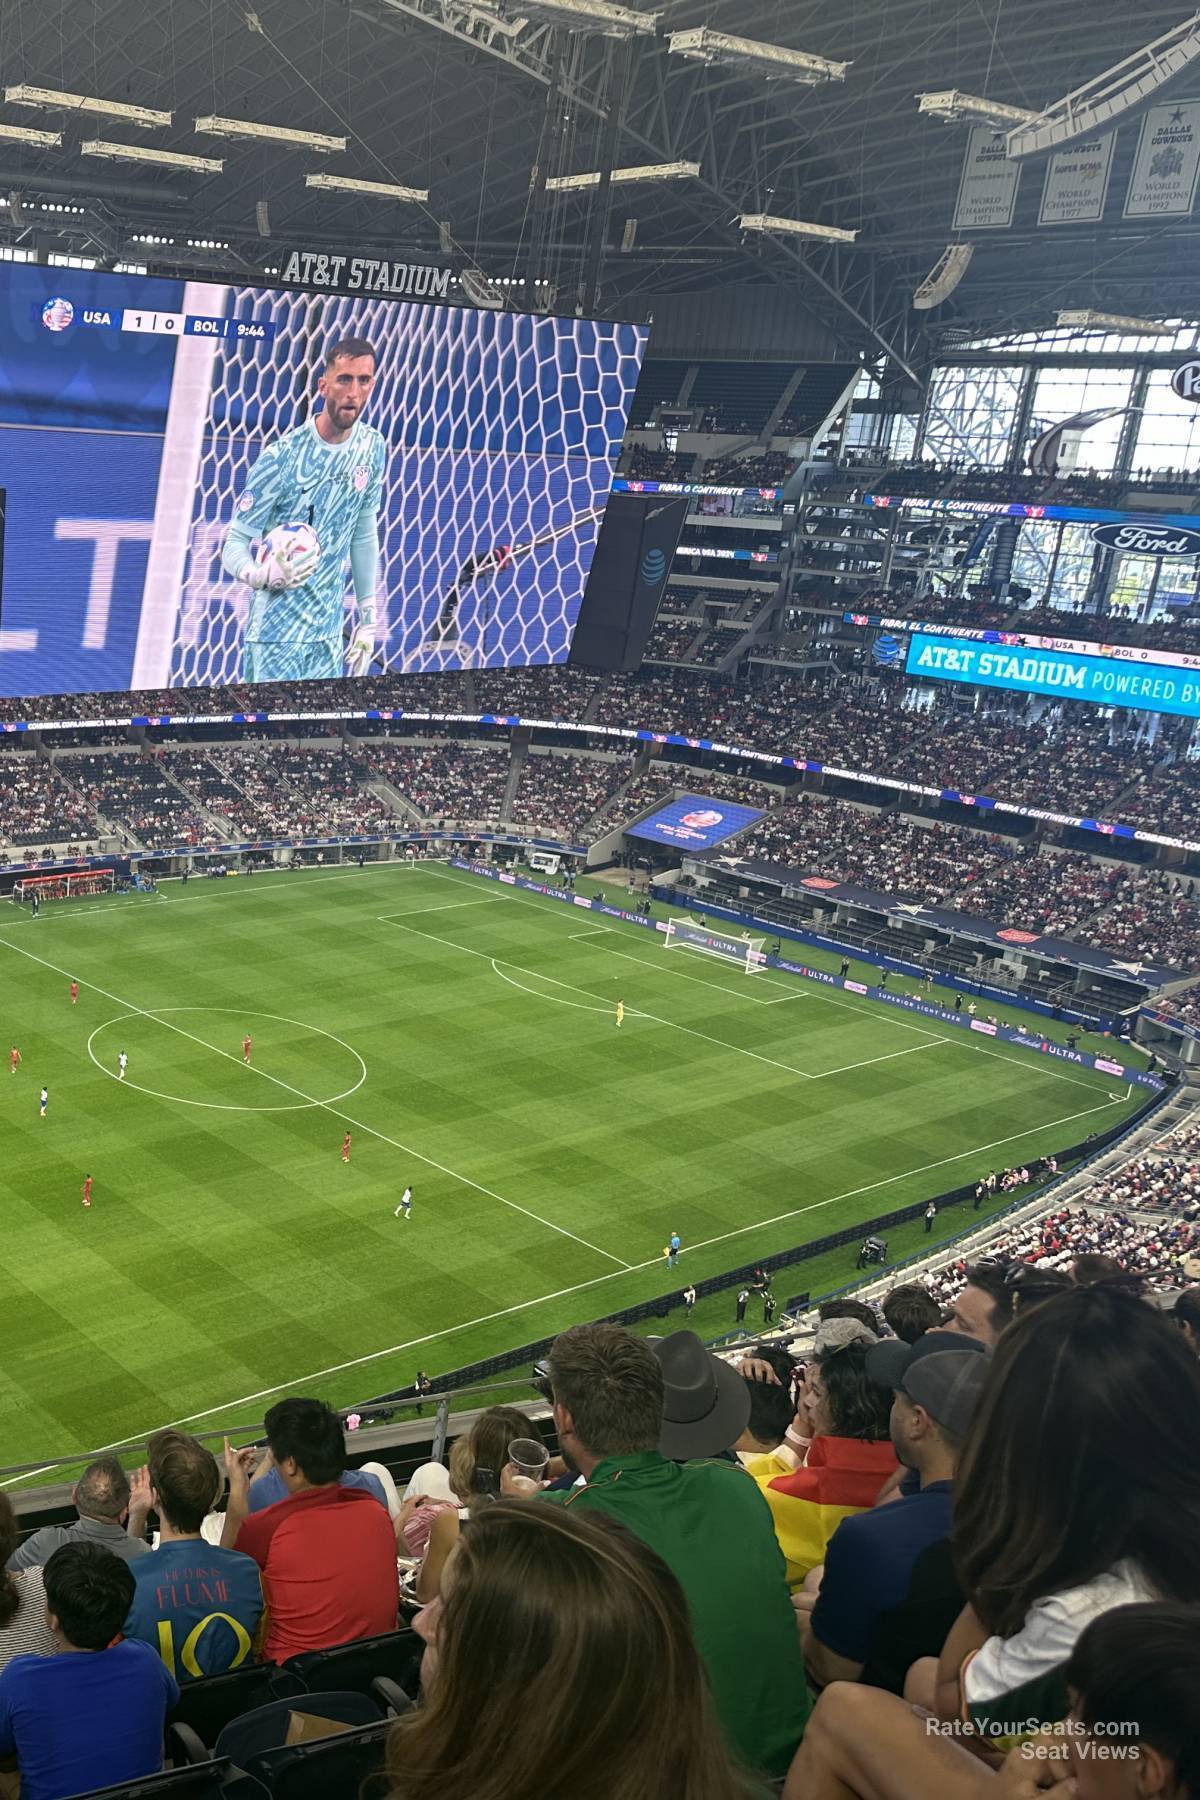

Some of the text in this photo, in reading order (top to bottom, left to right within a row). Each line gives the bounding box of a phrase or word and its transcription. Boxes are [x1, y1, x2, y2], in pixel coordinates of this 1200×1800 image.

[1157, 125, 1192, 136] DALLAS
[1151, 134, 1194, 145] COWBOYS
[1145, 182, 1180, 191] WORLD
[1058, 190, 1091, 199] WORLD
[1132, 192, 1189, 202] CHAMPIONS
[281, 252, 451, 297] AT&T STADIUM
[83, 311, 266, 338] USA 1 0 BOL 9:44
[658, 483, 745, 496] VIBRA O CONTINENTE
[902, 498, 1010, 513] VIBRA EL CONTINENTE
[1114, 527, 1189, 552] Ford
[702, 547, 716, 557] USA
[880, 618, 985, 638] VIBRA EL CONTINENTE
[1055, 641, 1148, 660] USA 1 BOL 0
[917, 645, 976, 672] AT&T
[978, 653, 1087, 689] STADIUM
[1092, 672, 1176, 700] POWERED
[821, 766, 859, 781] CONMEBOL
[994, 802, 1019, 814] VIBRA
[1028, 809, 1082, 826] CONTINENTE
[1134, 831, 1183, 848] CONMEBOL
[474, 866, 493, 878] ULTRA
[547, 888, 567, 900] ULTRA
[626, 913, 648, 926] ULTRA
[712, 939, 737, 953] ULTRA
[808, 970, 834, 984] ULTRA
[878, 992, 961, 1022] SUPERIOR LIGHT BEER
[1049, 1045, 1082, 1062] ULTRA
[157, 1612, 252, 1681] 10
